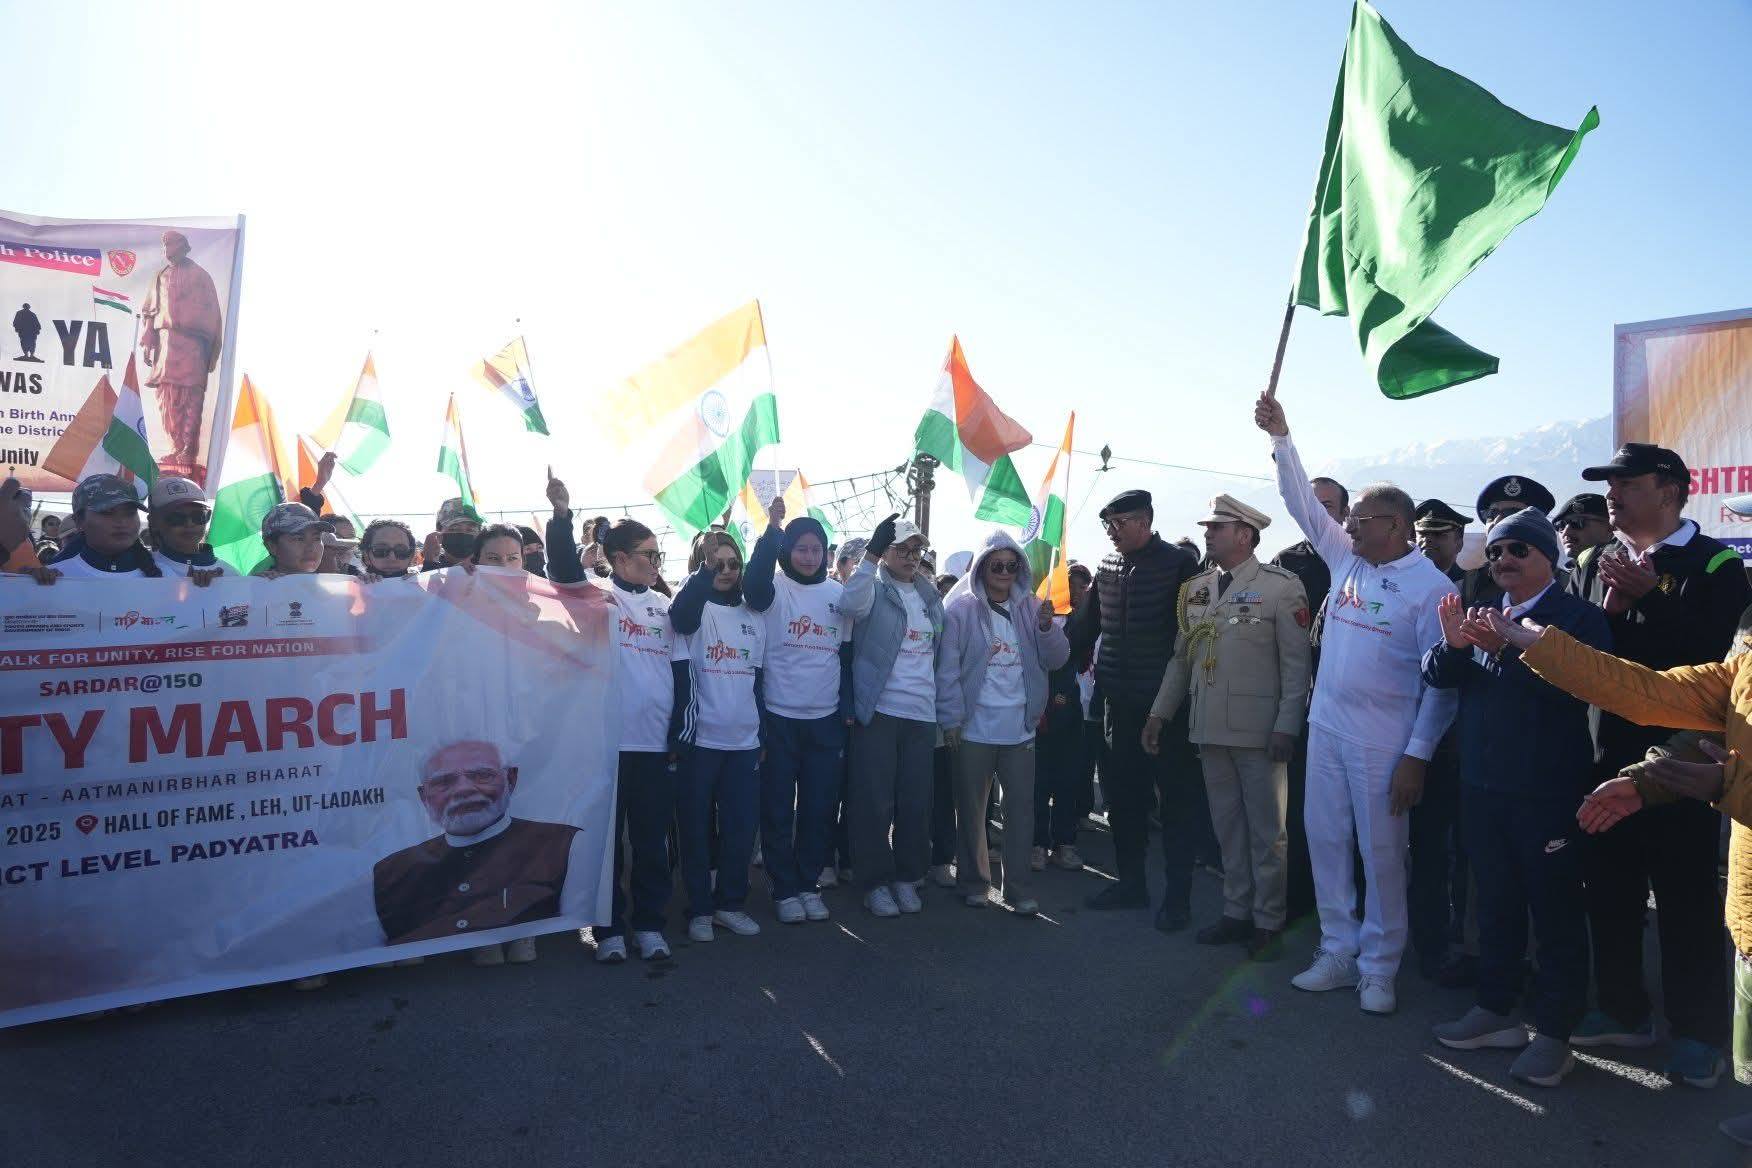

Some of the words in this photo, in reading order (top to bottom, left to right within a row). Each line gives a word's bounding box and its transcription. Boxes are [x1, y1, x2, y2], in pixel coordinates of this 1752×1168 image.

[24, 247, 96, 266] Police
[53, 319, 113, 369] YA
[10, 409, 45, 420] Birth
[49, 652, 89, 664] FOR
[95, 649, 158, 663] UNITY,
[165, 646, 205, 659] RISE
[211, 645, 246, 657] FOR
[252, 642, 314, 655] NATION
[39, 672, 203, 697] SARDAR@150
[128, 687, 407, 763] MARCH
[62, 773, 236, 801] AATMANIRBHAR
[246, 764, 322, 783] BHARAT
[6, 821, 61, 845] 2025
[104, 812, 151, 835] HALL
[157, 808, 179, 828] OF
[185, 803, 235, 825] FAME
[250, 797, 287, 817] LEH,
[292, 787, 384, 813] UT-LADAKH
[0, 861, 49, 885] CT
[61, 848, 161, 878] LEVEL
[171, 829, 319, 864] PADYATRA
